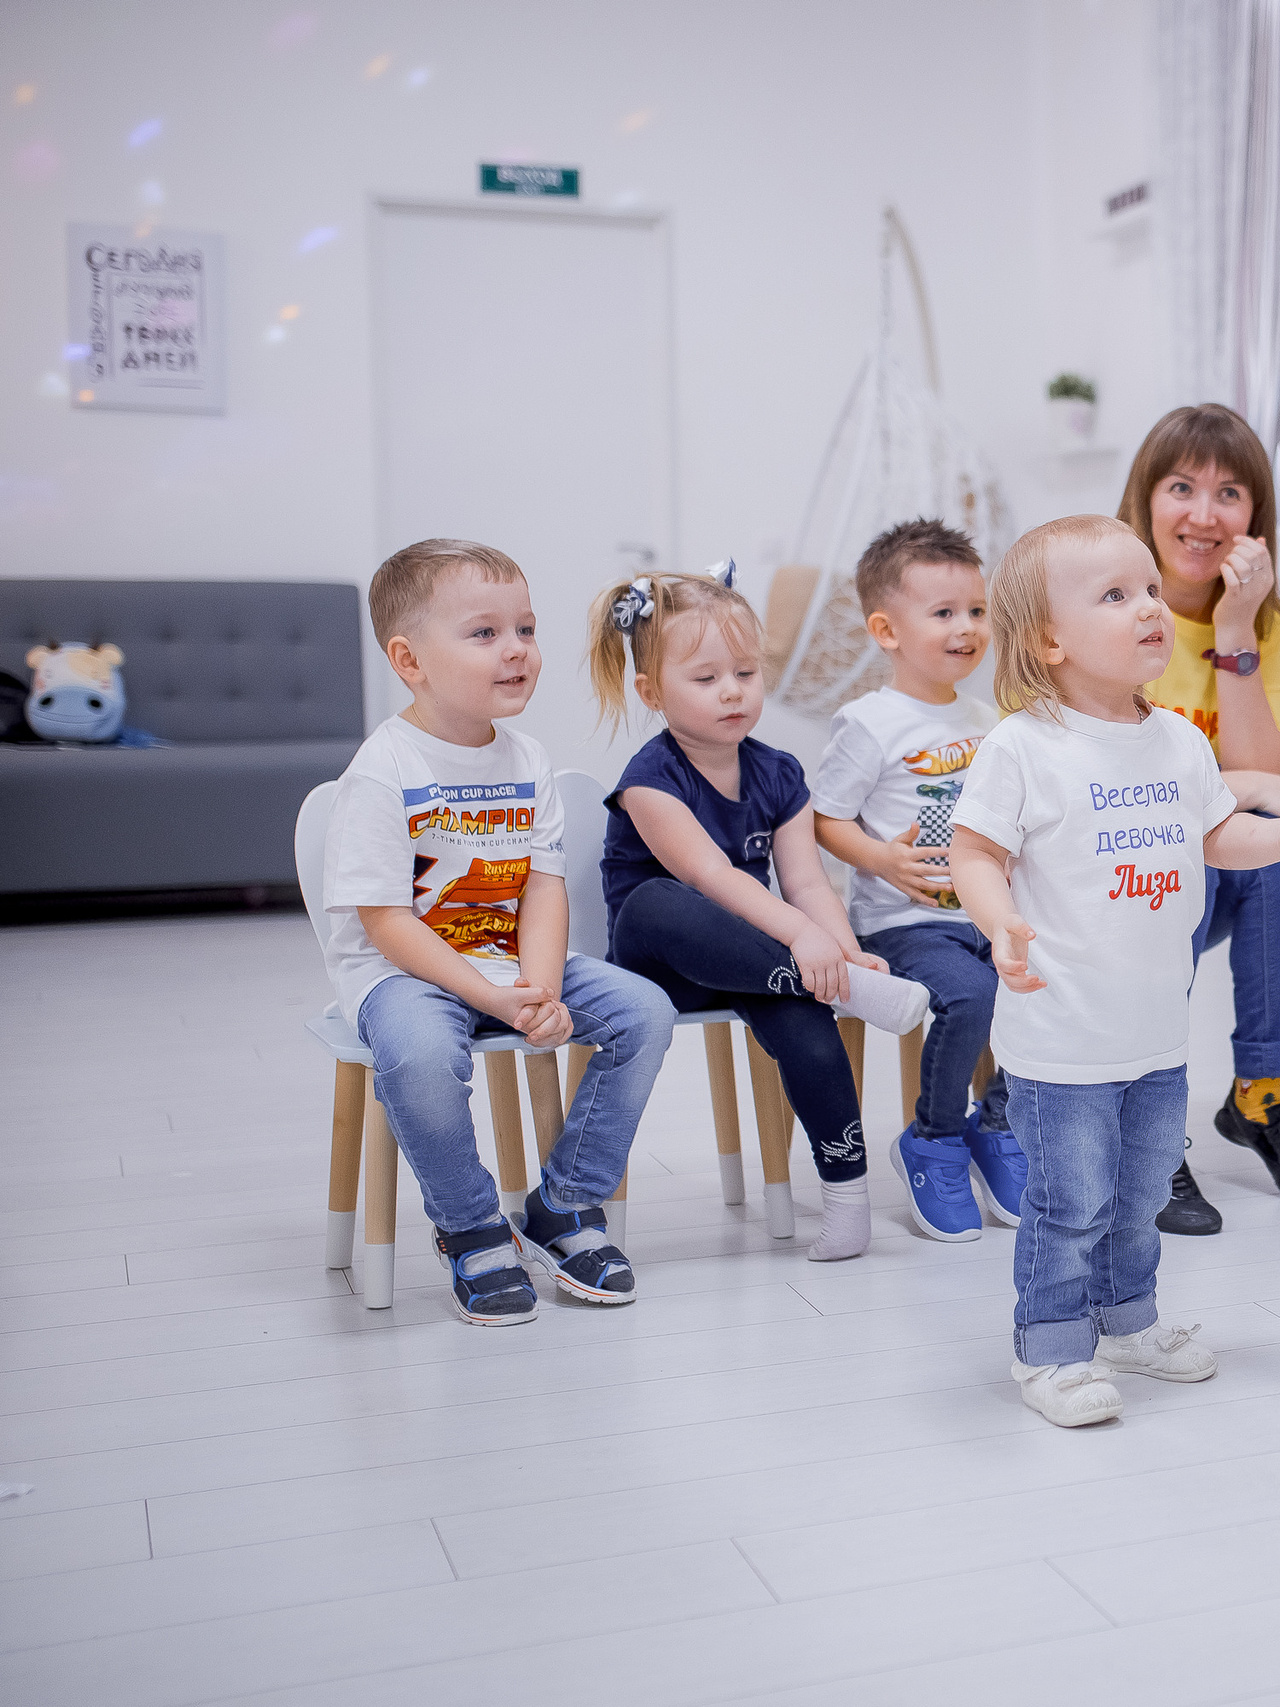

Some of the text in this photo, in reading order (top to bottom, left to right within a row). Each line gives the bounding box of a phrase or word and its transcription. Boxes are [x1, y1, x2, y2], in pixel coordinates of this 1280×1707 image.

[461, 787, 483, 799] CUP
[484, 785, 517, 799] RACER
[1089, 780, 1180, 811] Веселая
[489, 839, 505, 847] CUP
[506, 835, 532, 846] CHAM
[1096, 823, 1186, 856] девочка
[1108, 863, 1182, 911] Лиза
